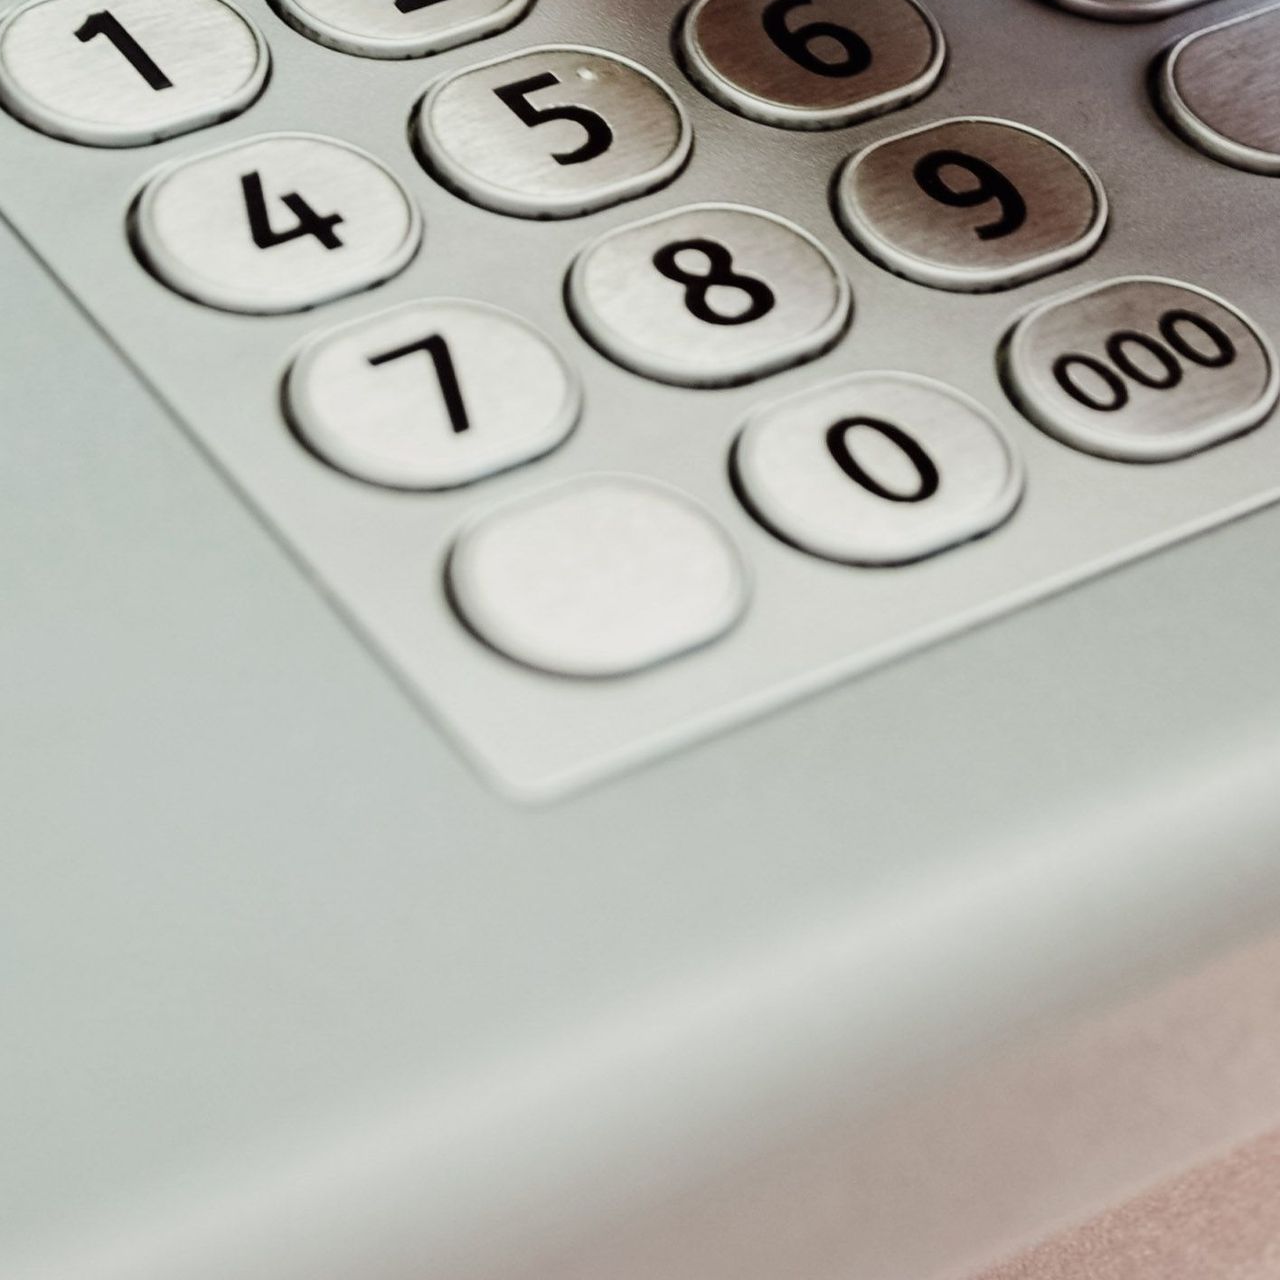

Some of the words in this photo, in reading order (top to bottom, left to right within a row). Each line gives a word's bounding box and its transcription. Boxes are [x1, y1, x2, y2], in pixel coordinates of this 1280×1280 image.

[74, 10, 173, 91] 1
[493, 72, 613, 166] 5
[241, 171, 344, 250] 4
[911, 145, 1028, 241] 9
[652, 238, 776, 326] 8
[369, 334, 470, 433] 7
[1052, 308, 1237, 412] 000
[825, 416, 940, 503] 0
